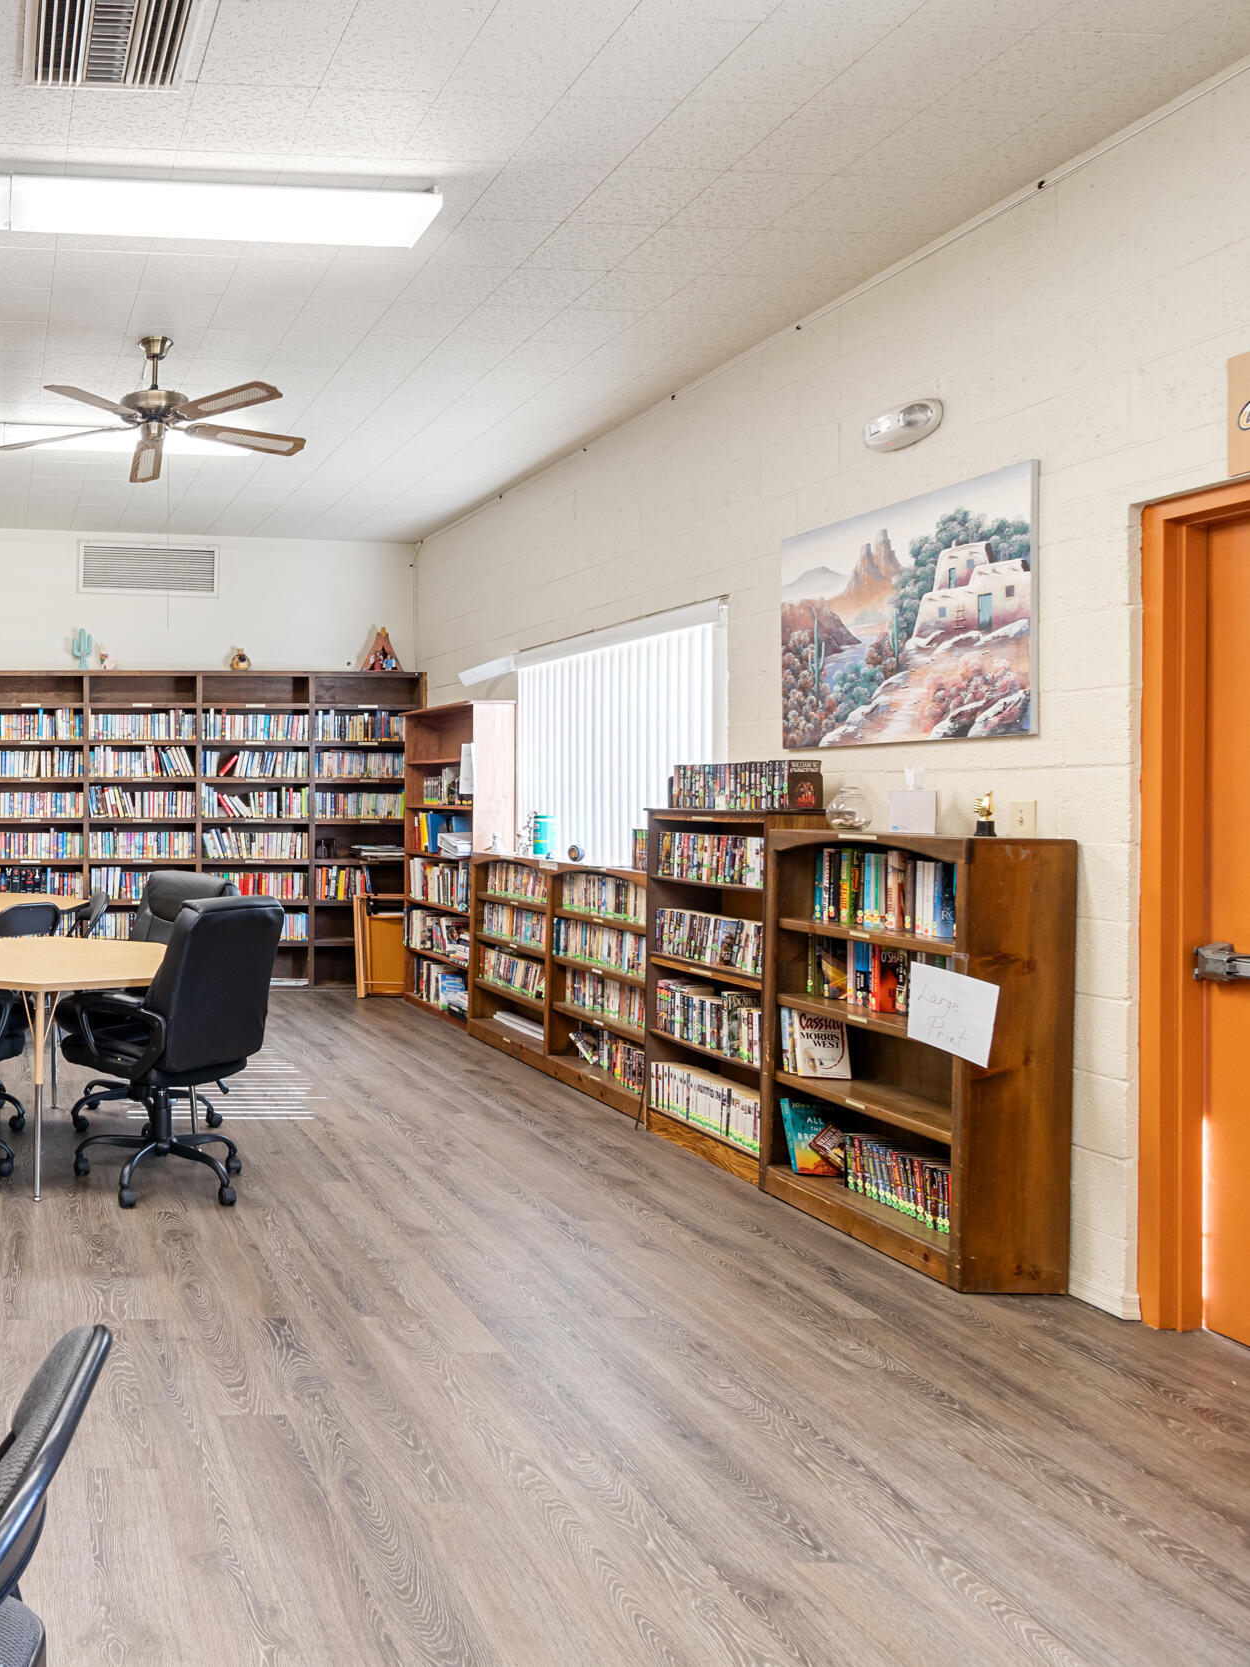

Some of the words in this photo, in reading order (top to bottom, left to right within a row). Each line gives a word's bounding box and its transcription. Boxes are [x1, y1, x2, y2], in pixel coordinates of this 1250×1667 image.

[917, 983, 960, 1017] Large
[800, 1032, 840, 1041] MORRIS
[813, 1040, 840, 1049] WEST
[806, 1116, 825, 1125] ALL
